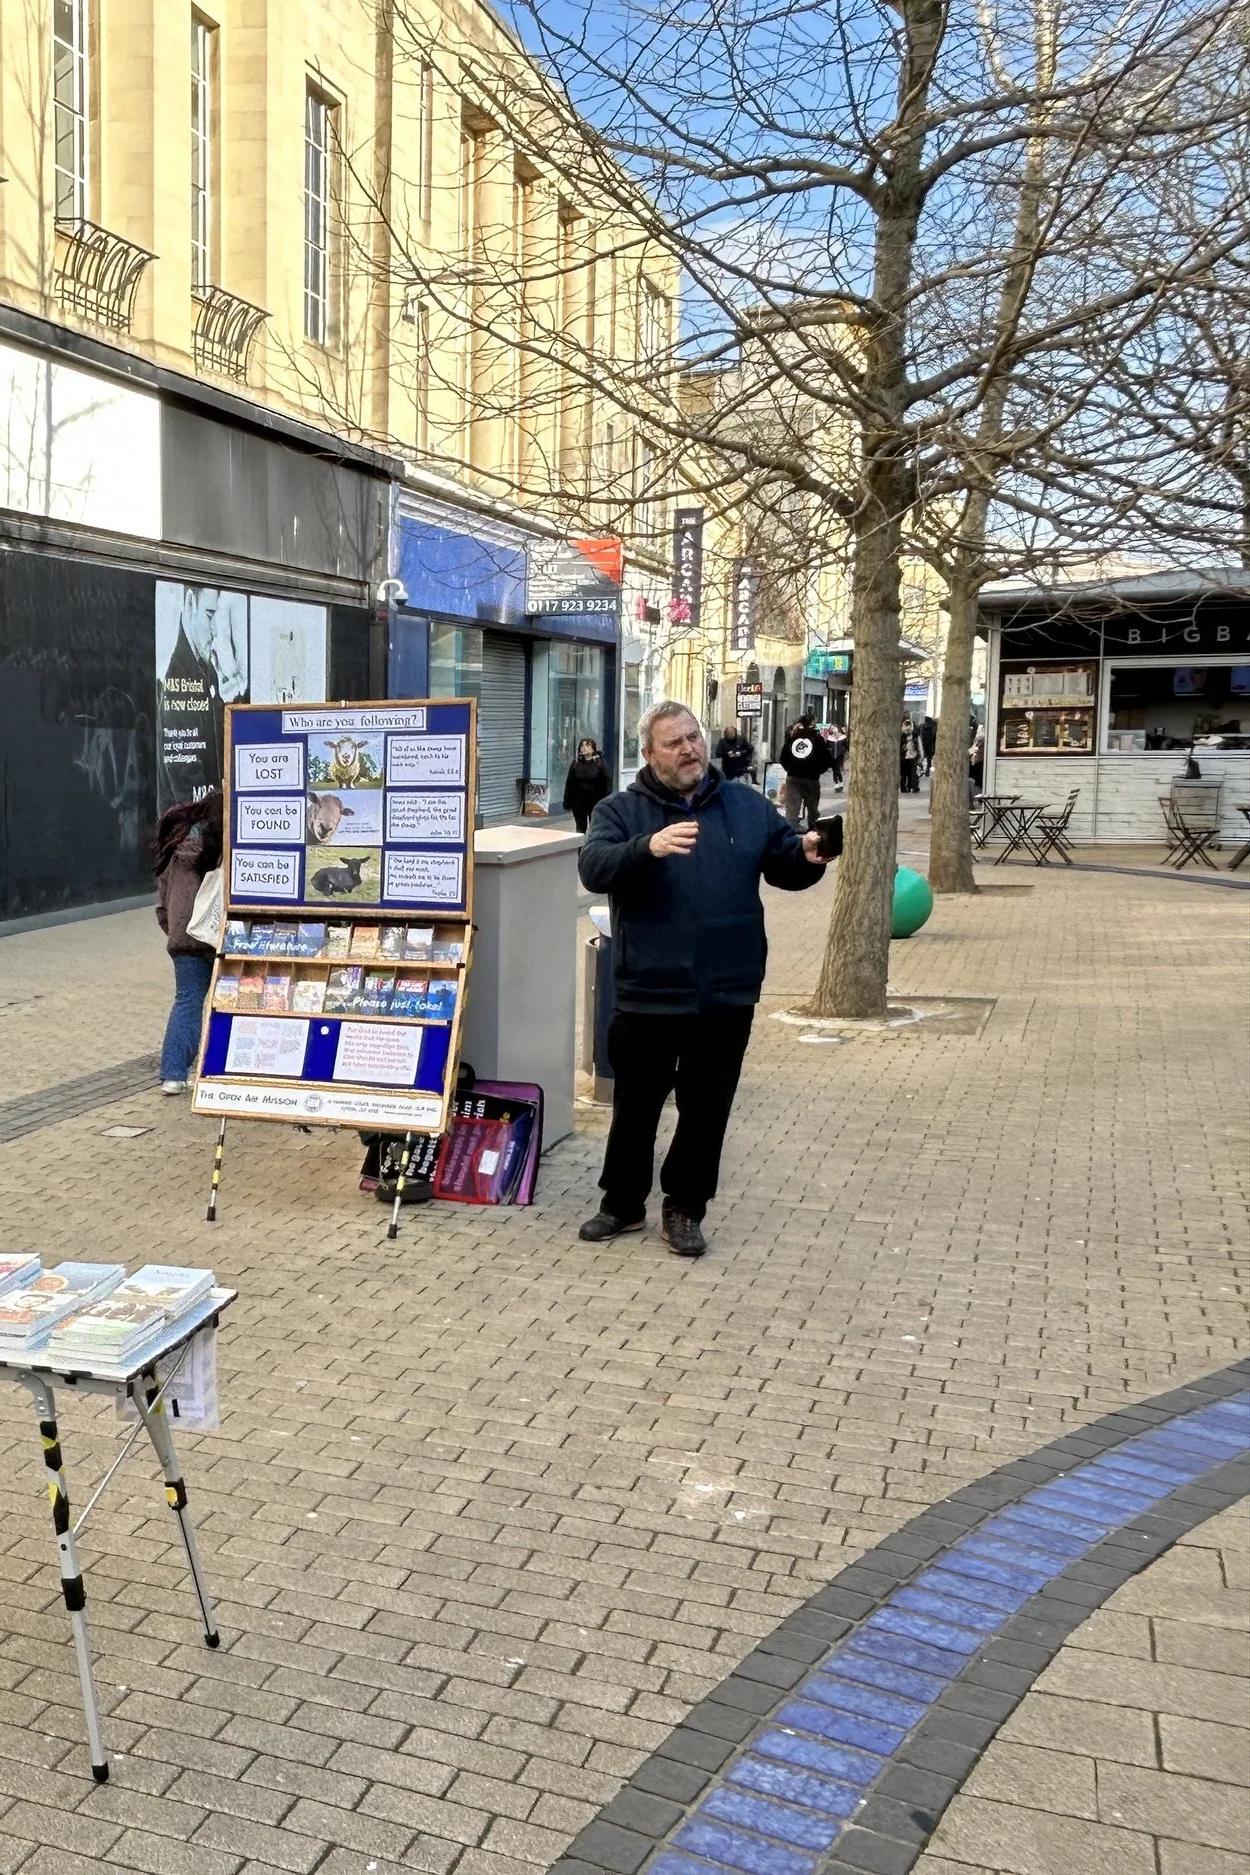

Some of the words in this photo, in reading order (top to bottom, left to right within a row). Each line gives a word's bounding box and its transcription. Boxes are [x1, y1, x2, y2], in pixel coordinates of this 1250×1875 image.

[527, 600, 558, 612] 0117
[561, 600, 583, 611] 923
[586, 600, 617, 611] 9234
[288, 716, 314, 728] Who
[316, 718, 332, 727] are
[334, 718, 354, 730] you
[360, 714, 418, 728] following?
[248, 753, 269, 764] You
[271, 755, 289, 764] are
[255, 768, 284, 780] LOST
[244, 805, 262, 816] You
[264, 807, 282, 816] can
[285, 805, 298, 816] be
[251, 819, 291, 830] FOUND
[235, 856, 254, 868] You
[257, 860, 274, 869] can
[277, 860, 290, 870] be
[240, 872, 290, 884] SATISFIED
[352, 996, 388, 1008] Please
